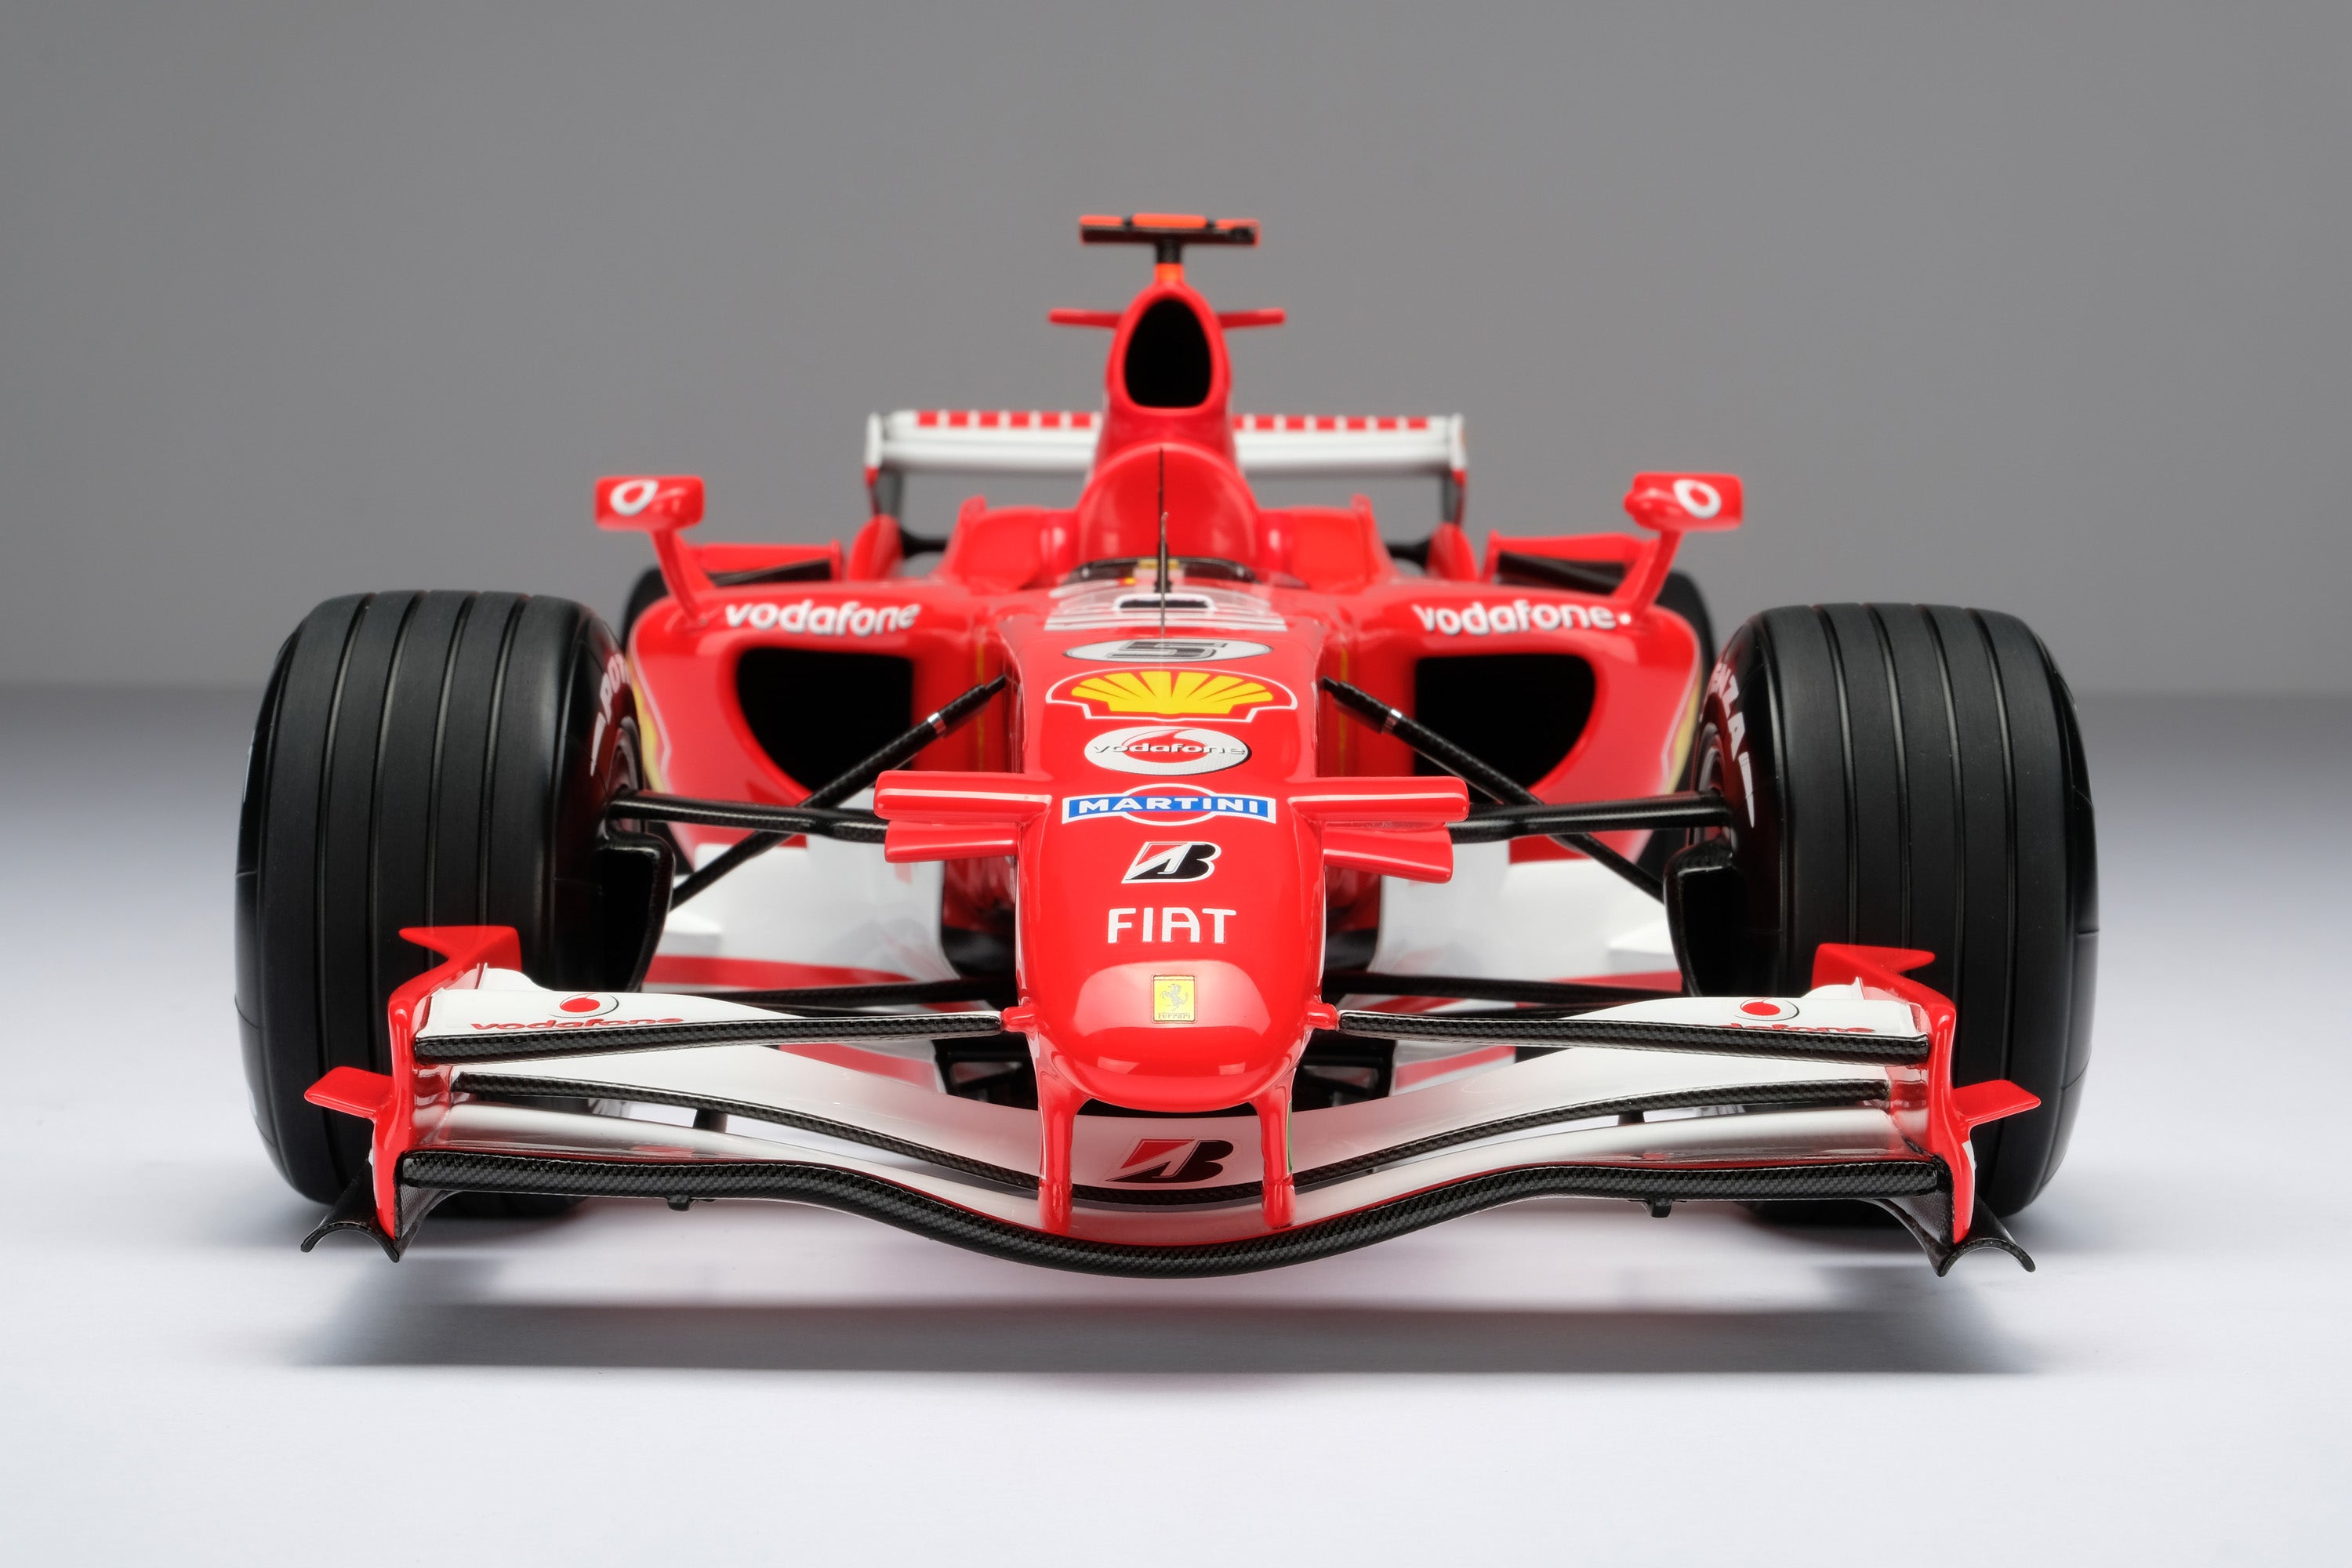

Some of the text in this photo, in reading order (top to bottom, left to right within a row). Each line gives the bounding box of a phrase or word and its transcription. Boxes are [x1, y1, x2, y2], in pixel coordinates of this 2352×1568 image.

[725, 599, 920, 637] vodafone
[1412, 599, 1617, 635] vodafone
[1106, 641, 1228, 659] 5
[1094, 743, 1247, 756] vodafone
[1079, 797, 1258, 814] MARTINI
[1107, 907, 1237, 944] FIAT
[470, 1018, 684, 1029] vodafone
